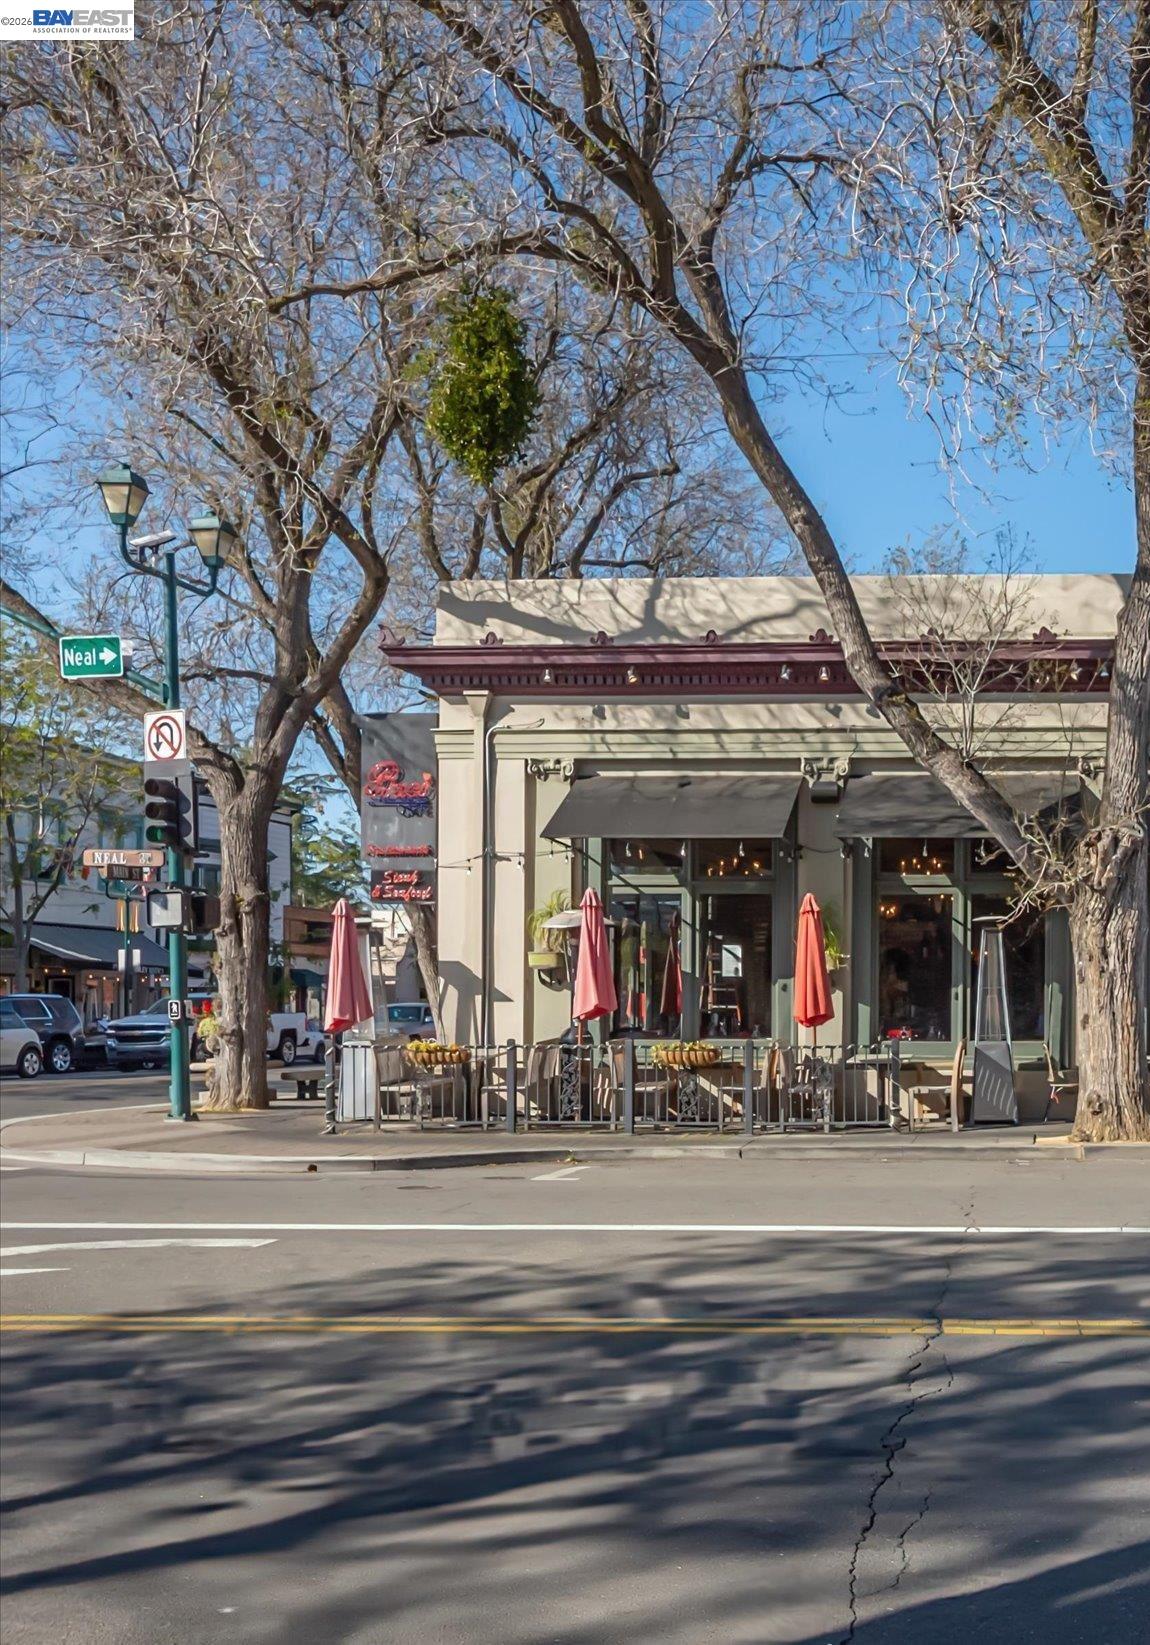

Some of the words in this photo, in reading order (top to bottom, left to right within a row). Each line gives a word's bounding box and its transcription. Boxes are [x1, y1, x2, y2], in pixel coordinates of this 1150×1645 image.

[64, 647, 97, 667] Neal
[94, 852, 127, 864] NEAL
[383, 885, 432, 901] Seafood
